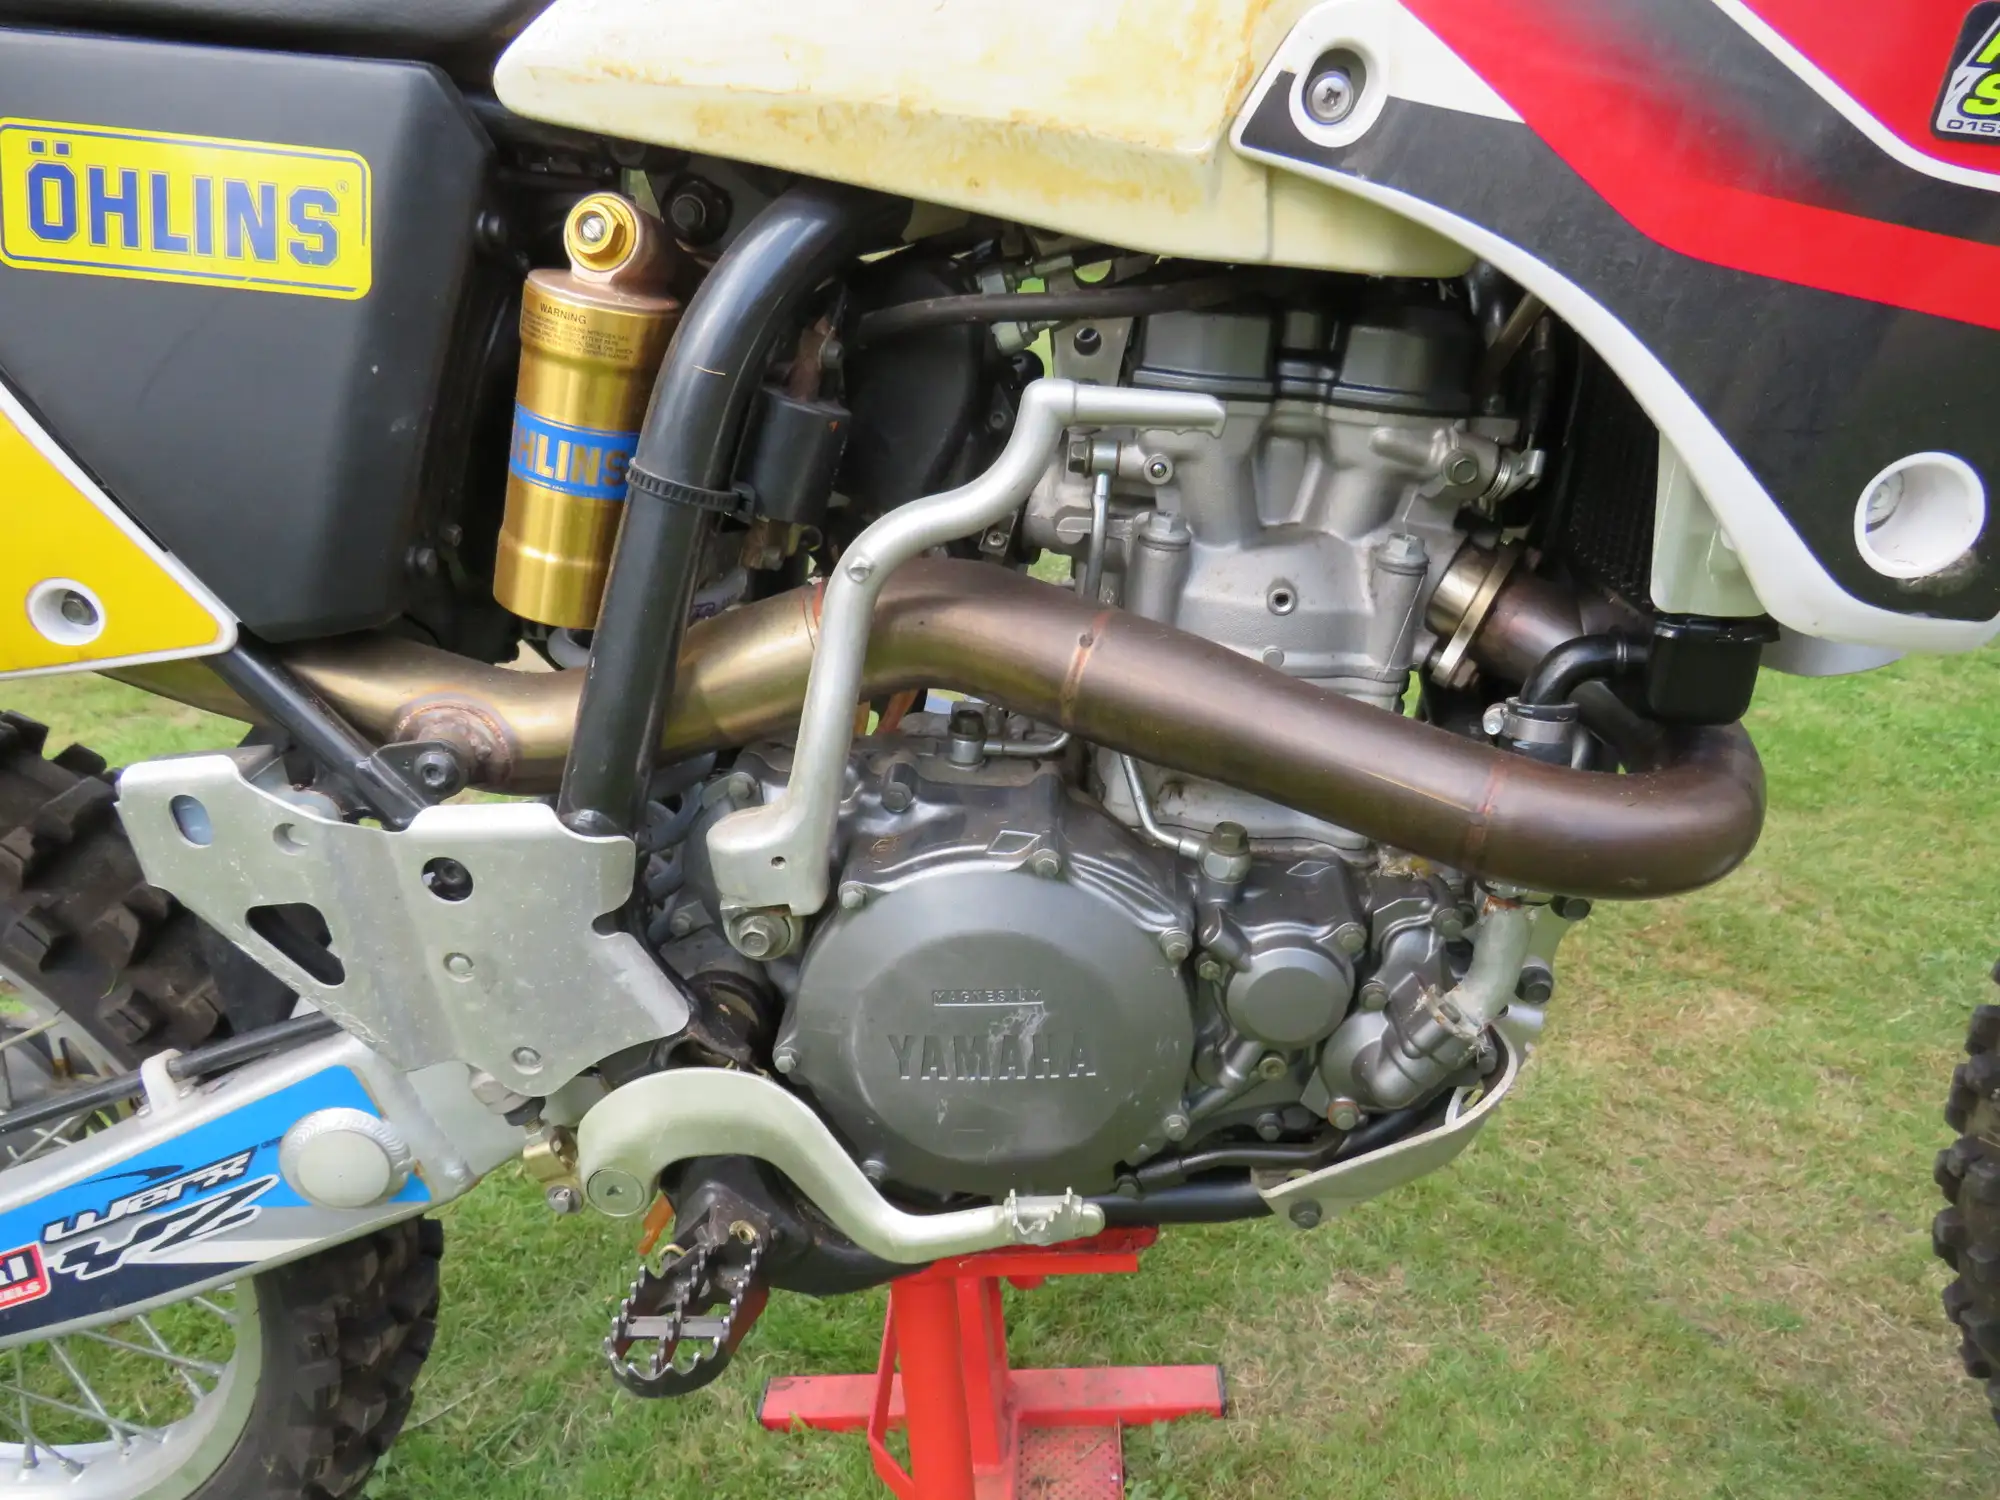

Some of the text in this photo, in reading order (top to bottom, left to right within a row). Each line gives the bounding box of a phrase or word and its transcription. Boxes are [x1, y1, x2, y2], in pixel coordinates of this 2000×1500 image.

[1946, 119, 2000, 134] 015
[26, 138, 340, 268] ÖHLINS
[540, 302, 587, 325] WARNING
[888, 1034, 1097, 1080] YAMAHA
